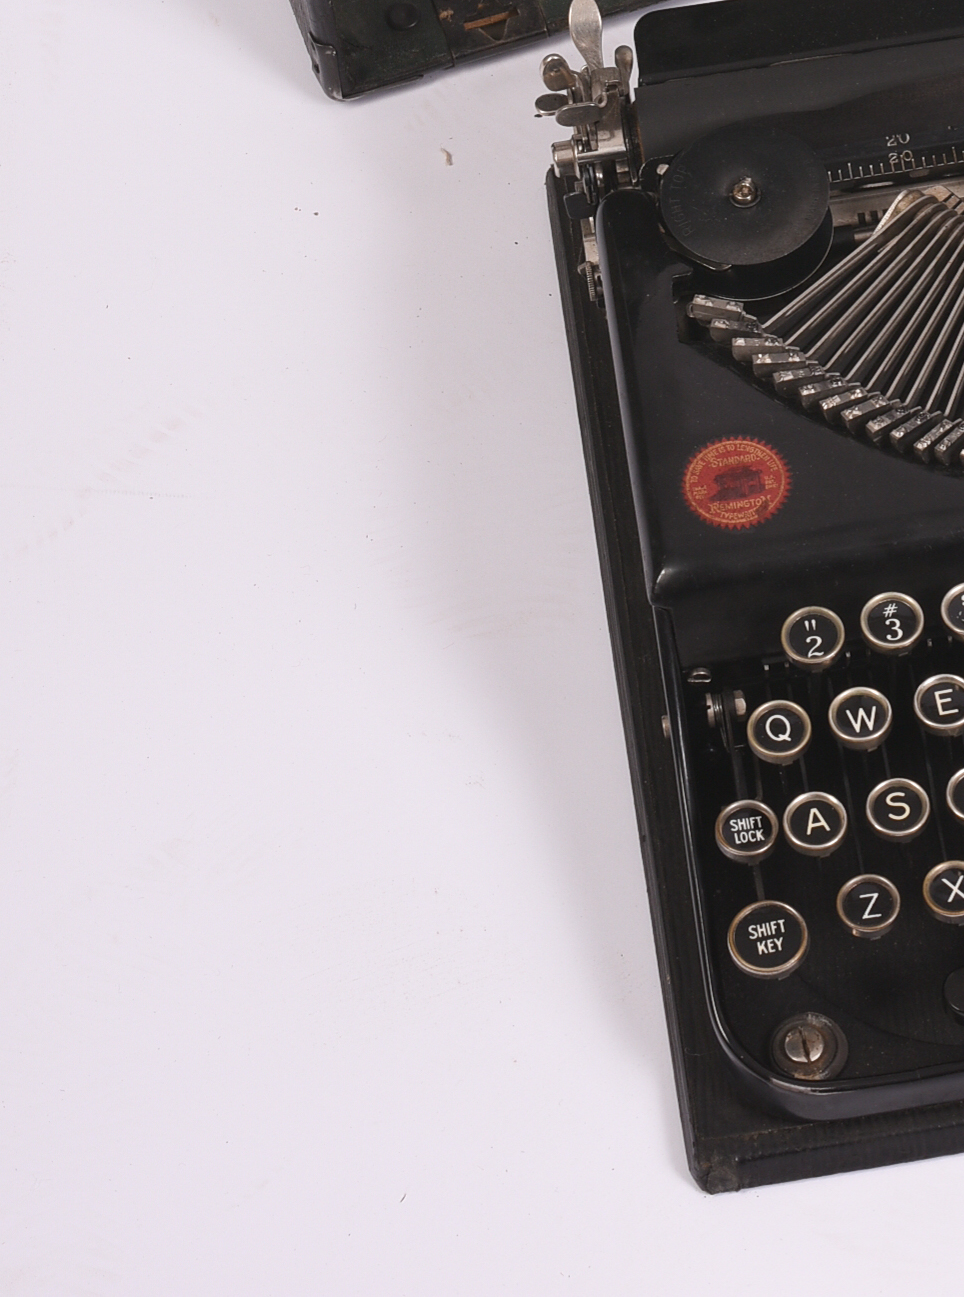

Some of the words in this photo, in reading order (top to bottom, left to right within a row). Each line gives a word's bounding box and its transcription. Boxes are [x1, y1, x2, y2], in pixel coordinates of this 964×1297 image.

[889, 150, 913, 164] 20
[806, 635, 825, 658] 2
[884, 618, 903, 641] 3
[764, 713, 792, 742] Q
[845, 705, 877, 734] W
[934, 688, 959, 716] E
[729, 815, 763, 832] SHIFT
[806, 807, 831, 835] A
[885, 792, 911, 821] S
[733, 828, 766, 844] LOCK
[859, 892, 882, 920] Z
[748, 919, 786, 940] SHIFT
[756, 937, 784, 954] KEY
